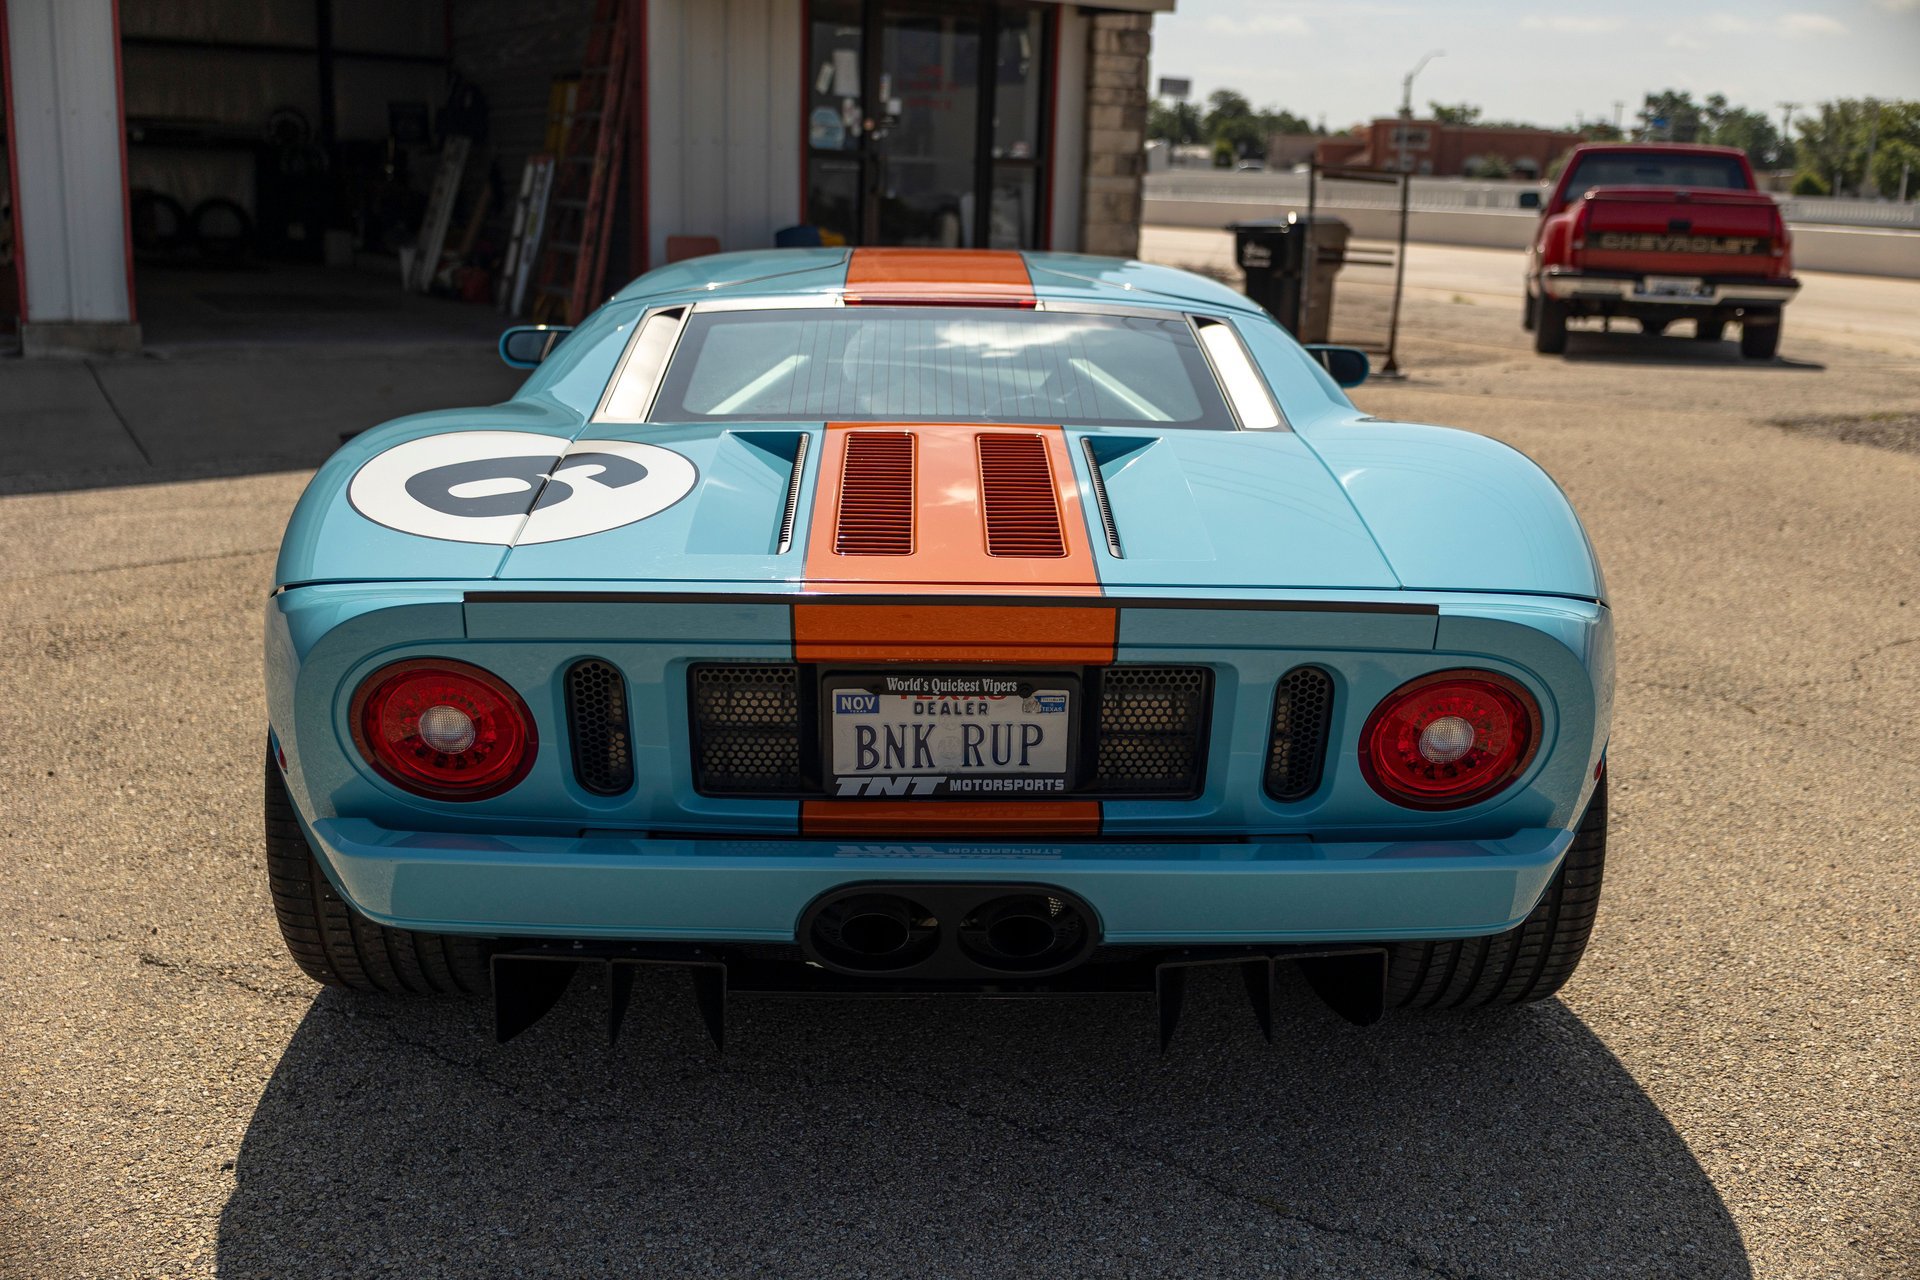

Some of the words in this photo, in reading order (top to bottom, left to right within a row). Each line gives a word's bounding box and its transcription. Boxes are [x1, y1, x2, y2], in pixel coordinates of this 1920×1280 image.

[1600, 233, 1759, 254] CHEVROLET
[886, 677, 929, 692] World's
[931, 678, 980, 694] Quickest
[982, 678, 1018, 694] Vipers
[841, 696, 876, 710] NOV
[914, 702, 989, 715] DEALER
[855, 723, 936, 770] BNK
[961, 723, 1044, 767] RUP
[835, 776, 948, 796] TNT
[949, 779, 1065, 793] MOTORSPORTS
